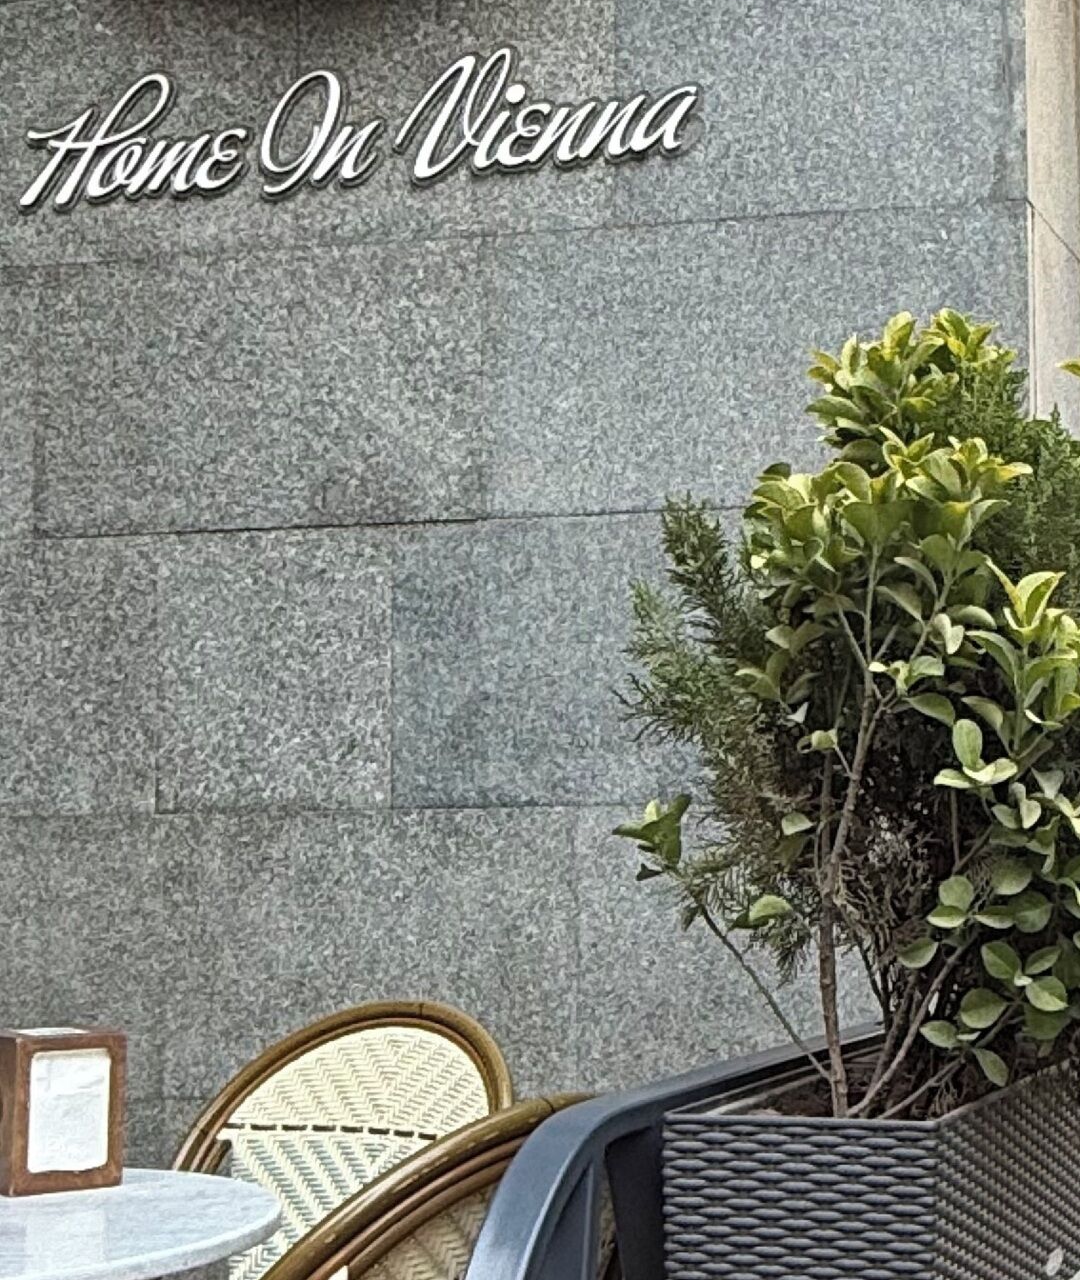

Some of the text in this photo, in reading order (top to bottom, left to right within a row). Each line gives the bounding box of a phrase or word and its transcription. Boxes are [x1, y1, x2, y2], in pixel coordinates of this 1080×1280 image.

[19, 47, 698, 208] Home On Vienna
